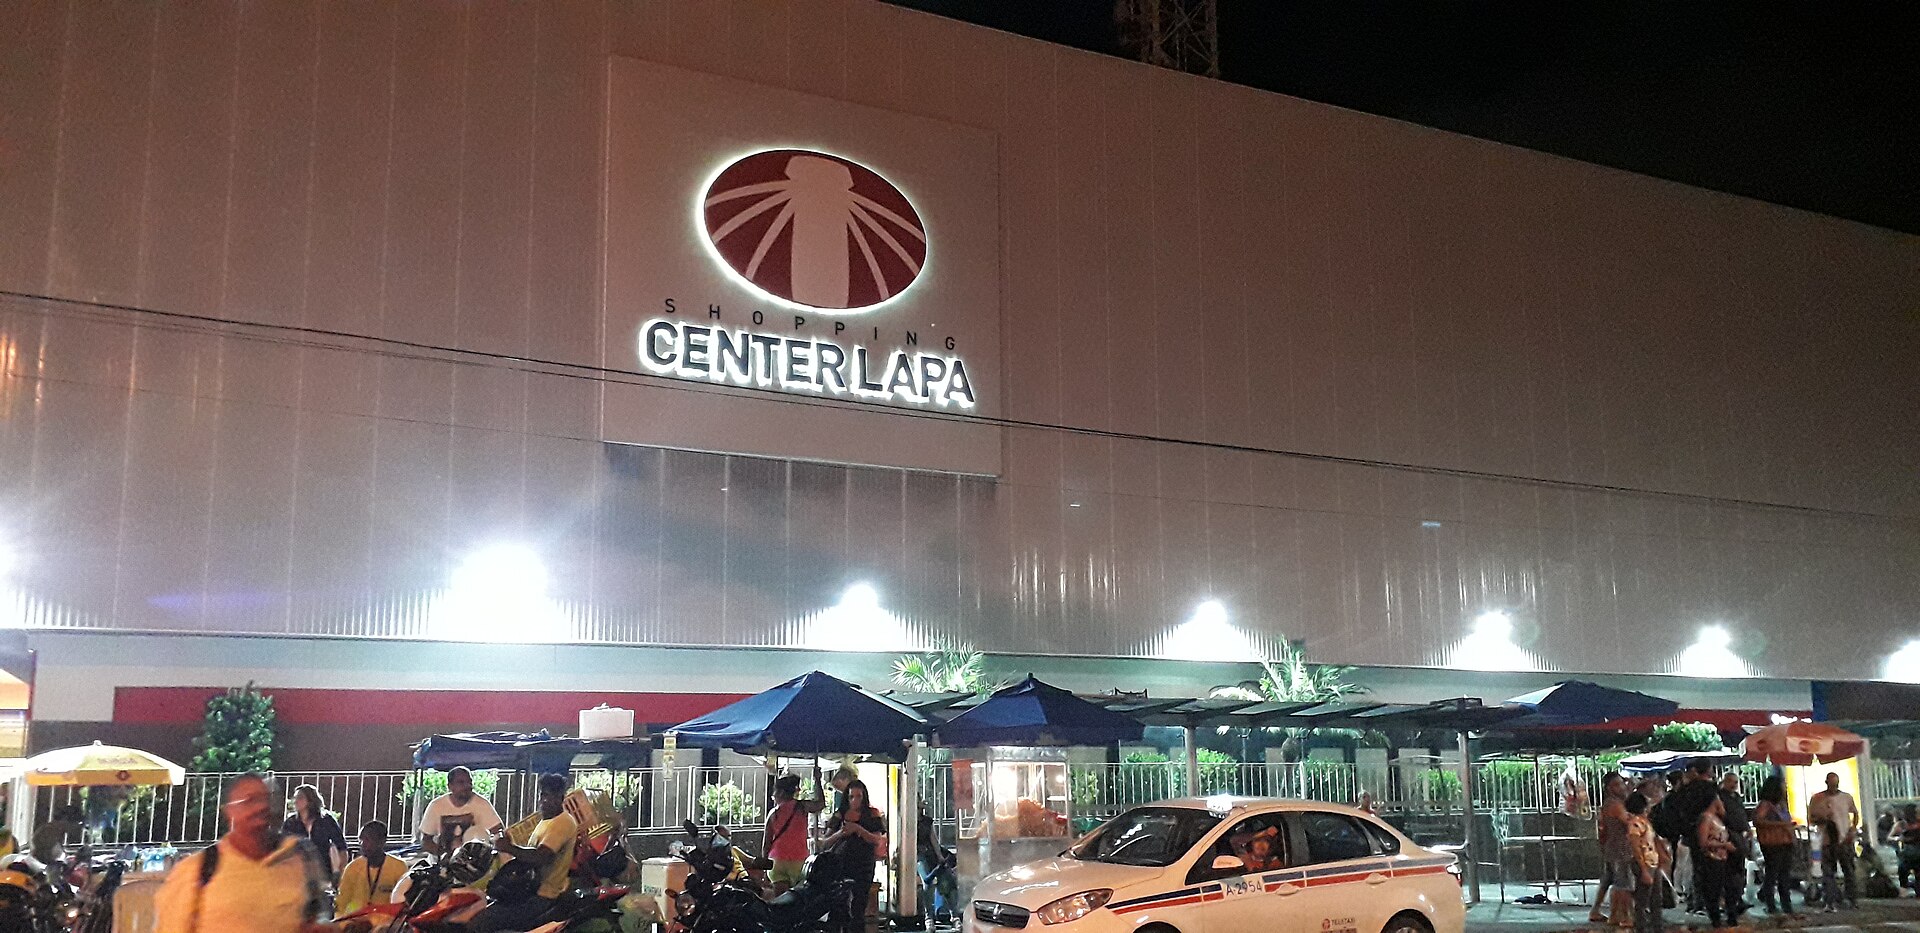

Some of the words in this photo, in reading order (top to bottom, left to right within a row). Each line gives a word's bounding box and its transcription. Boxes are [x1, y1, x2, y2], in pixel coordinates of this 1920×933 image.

[665, 298, 956, 351] SHOPPING
[644, 320, 846, 390] CENTER
[857, 347, 975, 403] LAPA
[1226, 881, 1263, 896] A-2954
